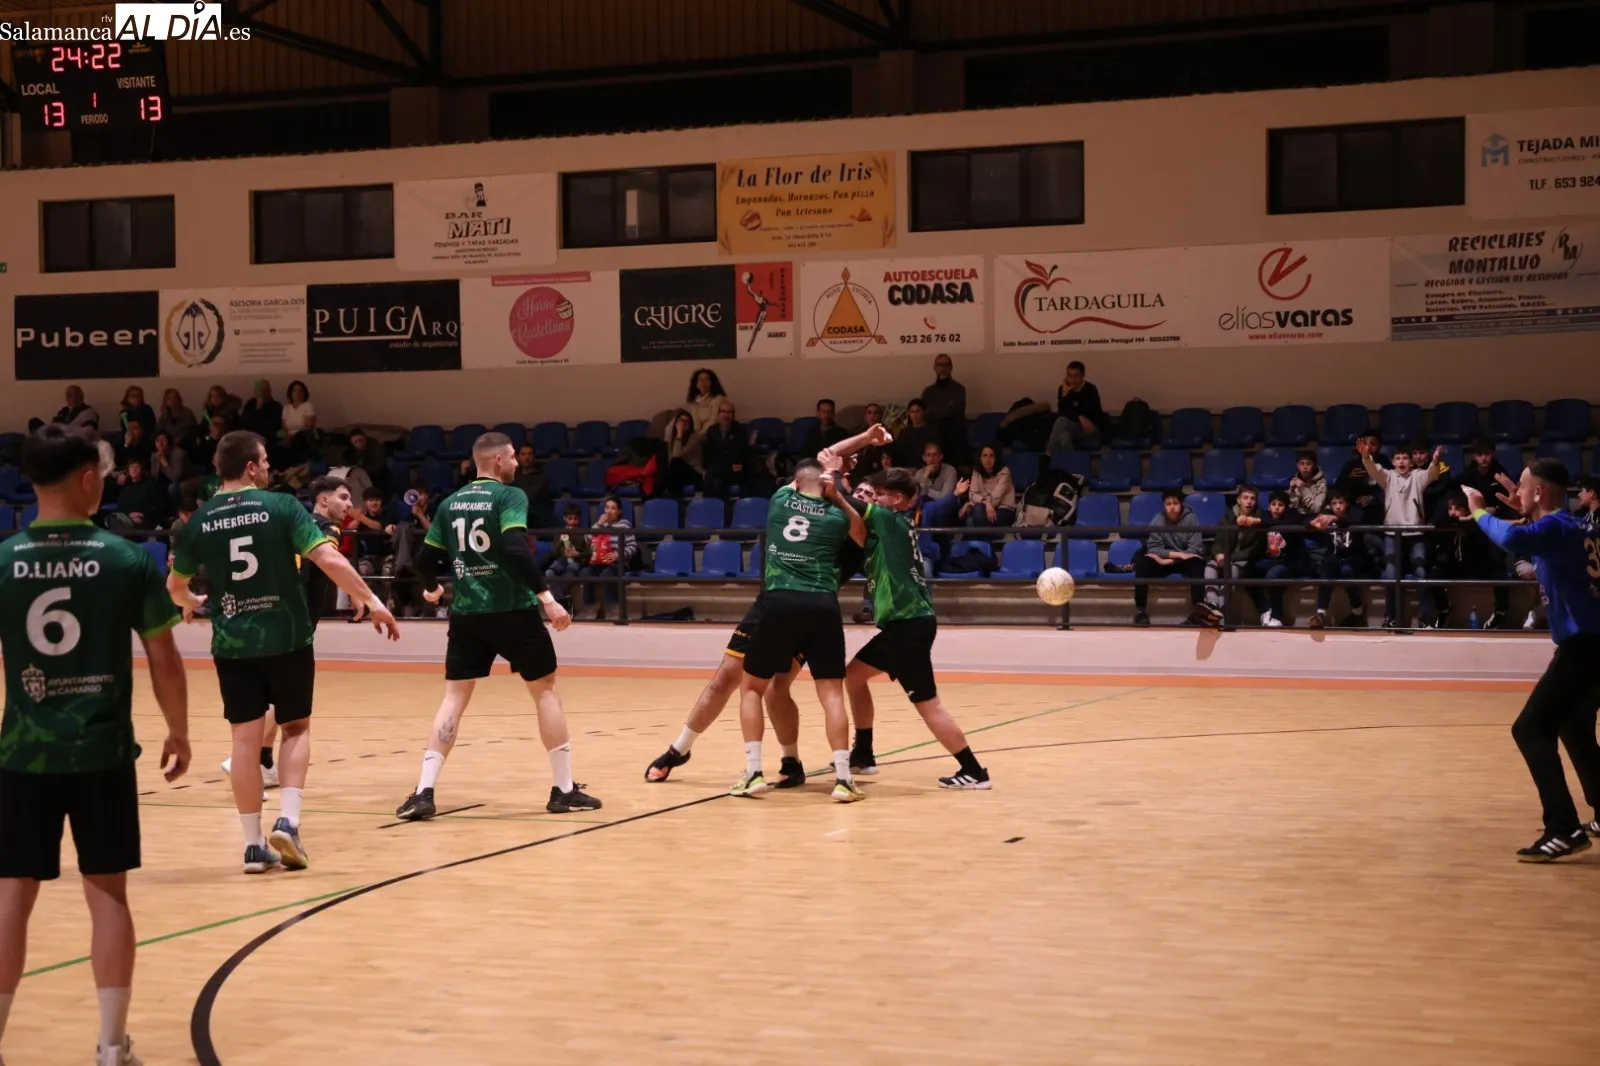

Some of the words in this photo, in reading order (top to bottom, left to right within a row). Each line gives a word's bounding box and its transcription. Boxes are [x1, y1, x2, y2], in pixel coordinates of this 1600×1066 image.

[51, 43, 121, 72] 24:22
[21, 82, 60, 96] LOCAL
[116, 76, 156, 89] VISITANTE
[92, 92, 97, 108] 1
[140, 96, 162, 121] 13
[44, 102, 65, 127] 13
[81, 114, 108, 125] PERIODO
[1517, 137, 1575, 155] TEJADA
[736, 169, 758, 188] La
[764, 167, 804, 186] Flor
[810, 164, 832, 184] de
[839, 162, 873, 182] Iris
[1554, 177, 1577, 189] 653
[832, 190, 849, 200] Pan
[851, 189, 875, 200] pizza
[444, 211, 483, 220] BAR
[775, 208, 792, 217] Pan
[448, 217, 511, 240] MATI
[1448, 231, 1546, 253] RECICLAJES
[1448, 254, 1542, 275] MONTALVO
[882, 268, 979, 284] AUTOESCUELA
[826, 286, 841, 300] AUTO
[887, 282, 975, 307] CODASA
[1033, 292, 1167, 312] TARDAGUILA
[1218, 305, 1354, 331] elíasvaras
[16, 326, 157, 349] Pubeer
[827, 325, 866, 335] CODASA
[900, 334, 918, 345] 923
[920, 334, 932, 344] 26
[934, 334, 947, 344] 76
[948, 333, 962, 343] 02
[237, 500, 263, 508] CAMARGO
[790, 501, 825, 516] CASTILLO
[202, 511, 270, 533] N.HERRERO
[782, 515, 810, 542] 8
[451, 517, 491, 554] 16
[13, 557, 100, 578] D.LIAÑO
[229, 535, 259, 581] 5
[1583, 536, 1600, 579] 3
[26, 586, 81, 656] 6
[47, 674, 115, 687] AYUNTAMIENTO
[57, 684, 102, 695] CAMARGO
